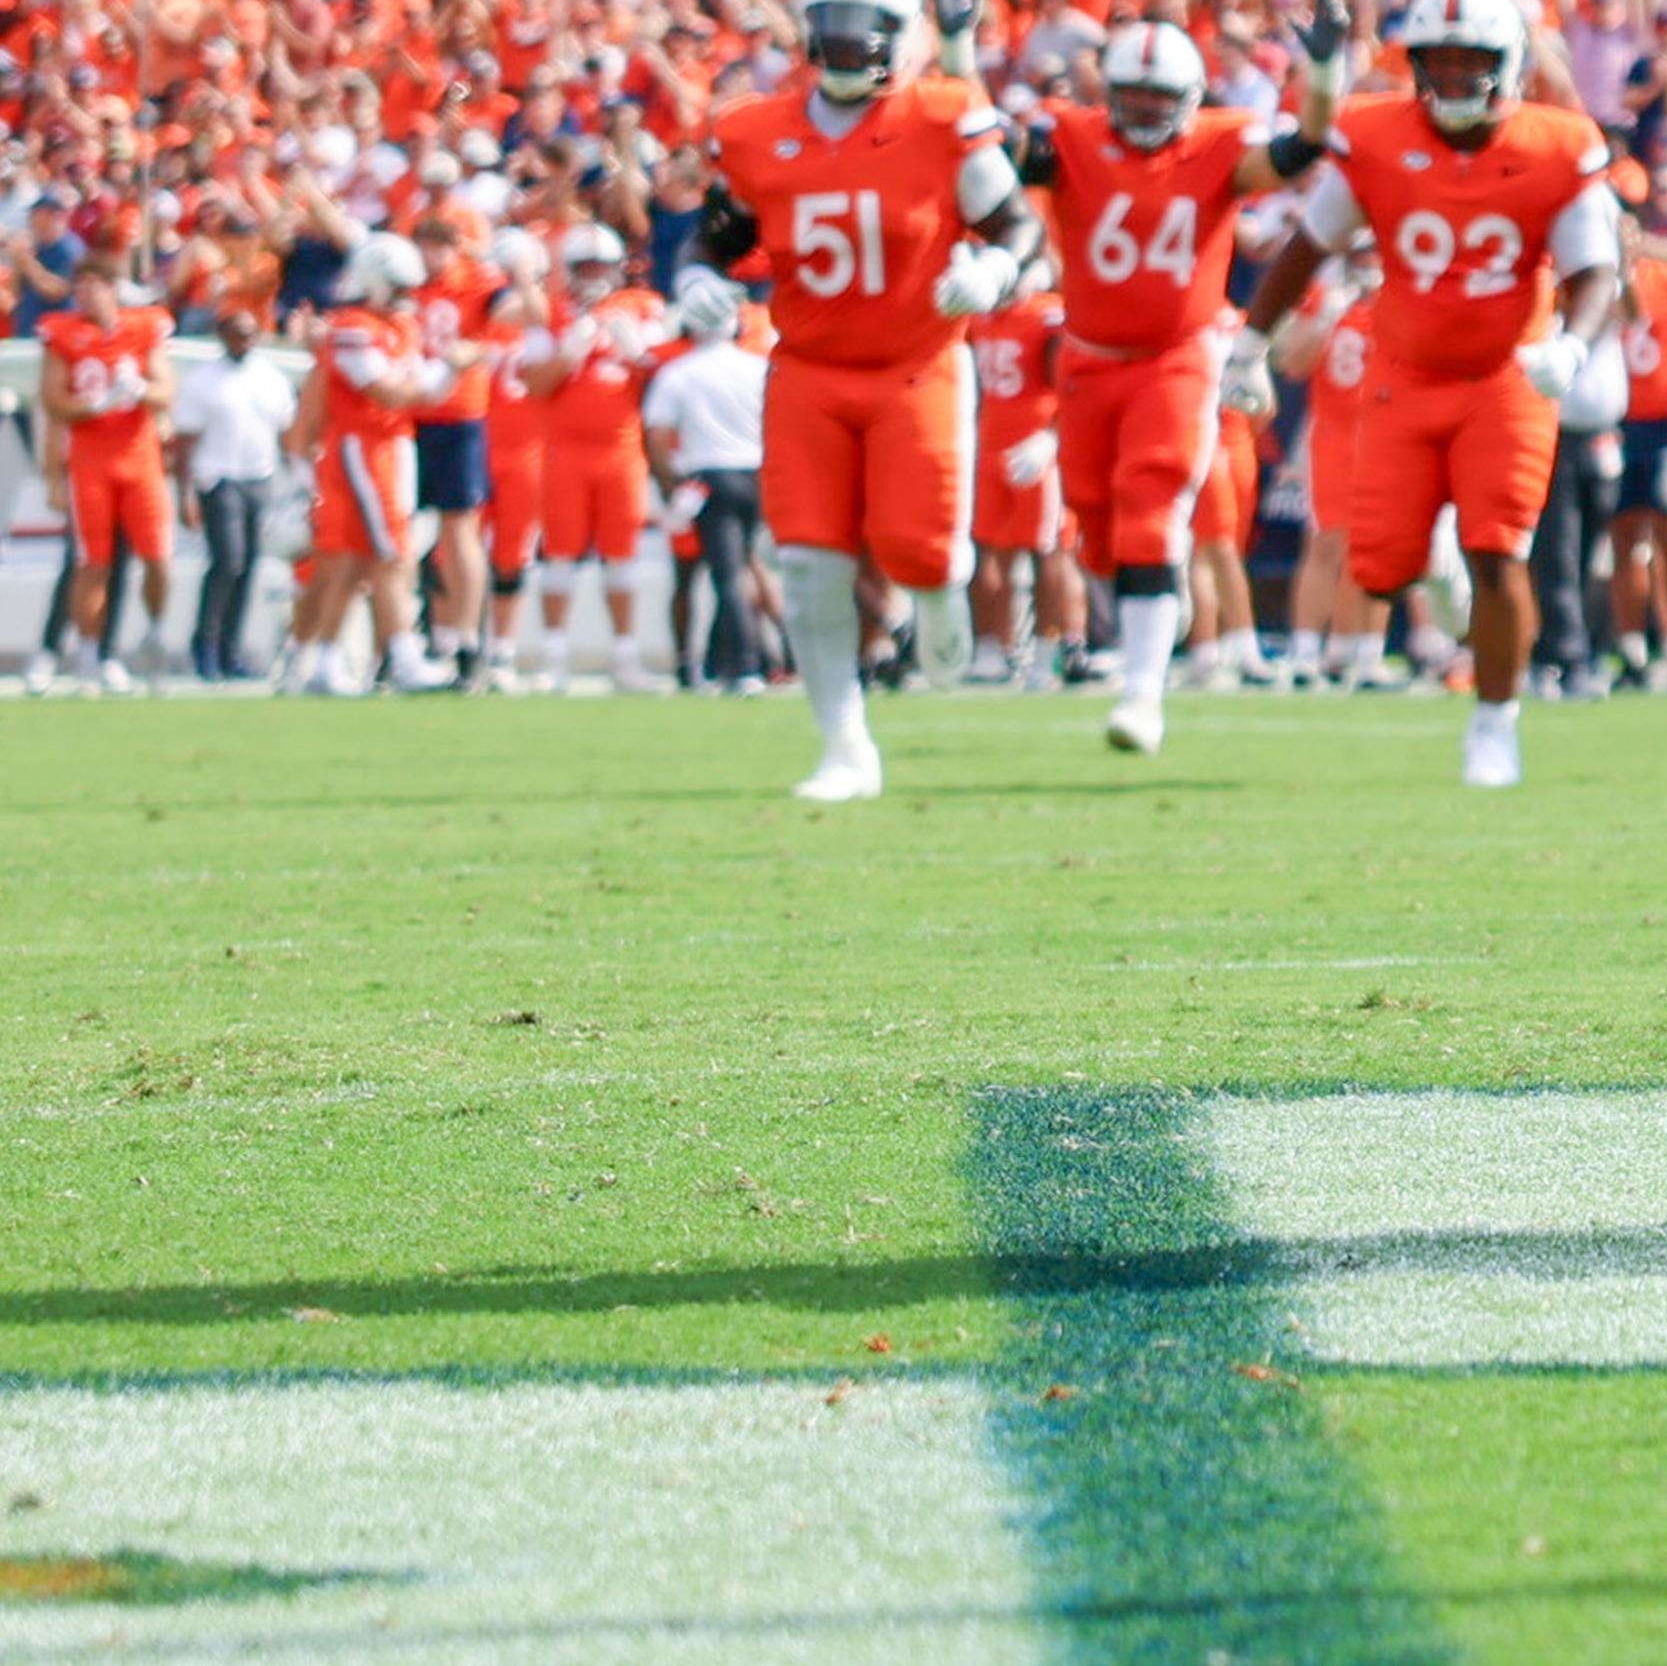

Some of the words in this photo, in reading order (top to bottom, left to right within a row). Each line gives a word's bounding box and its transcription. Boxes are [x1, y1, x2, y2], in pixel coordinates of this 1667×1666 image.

[792, 189, 886, 299] 51
[1089, 193, 1199, 288] 64
[1395, 210, 1525, 301] 92
